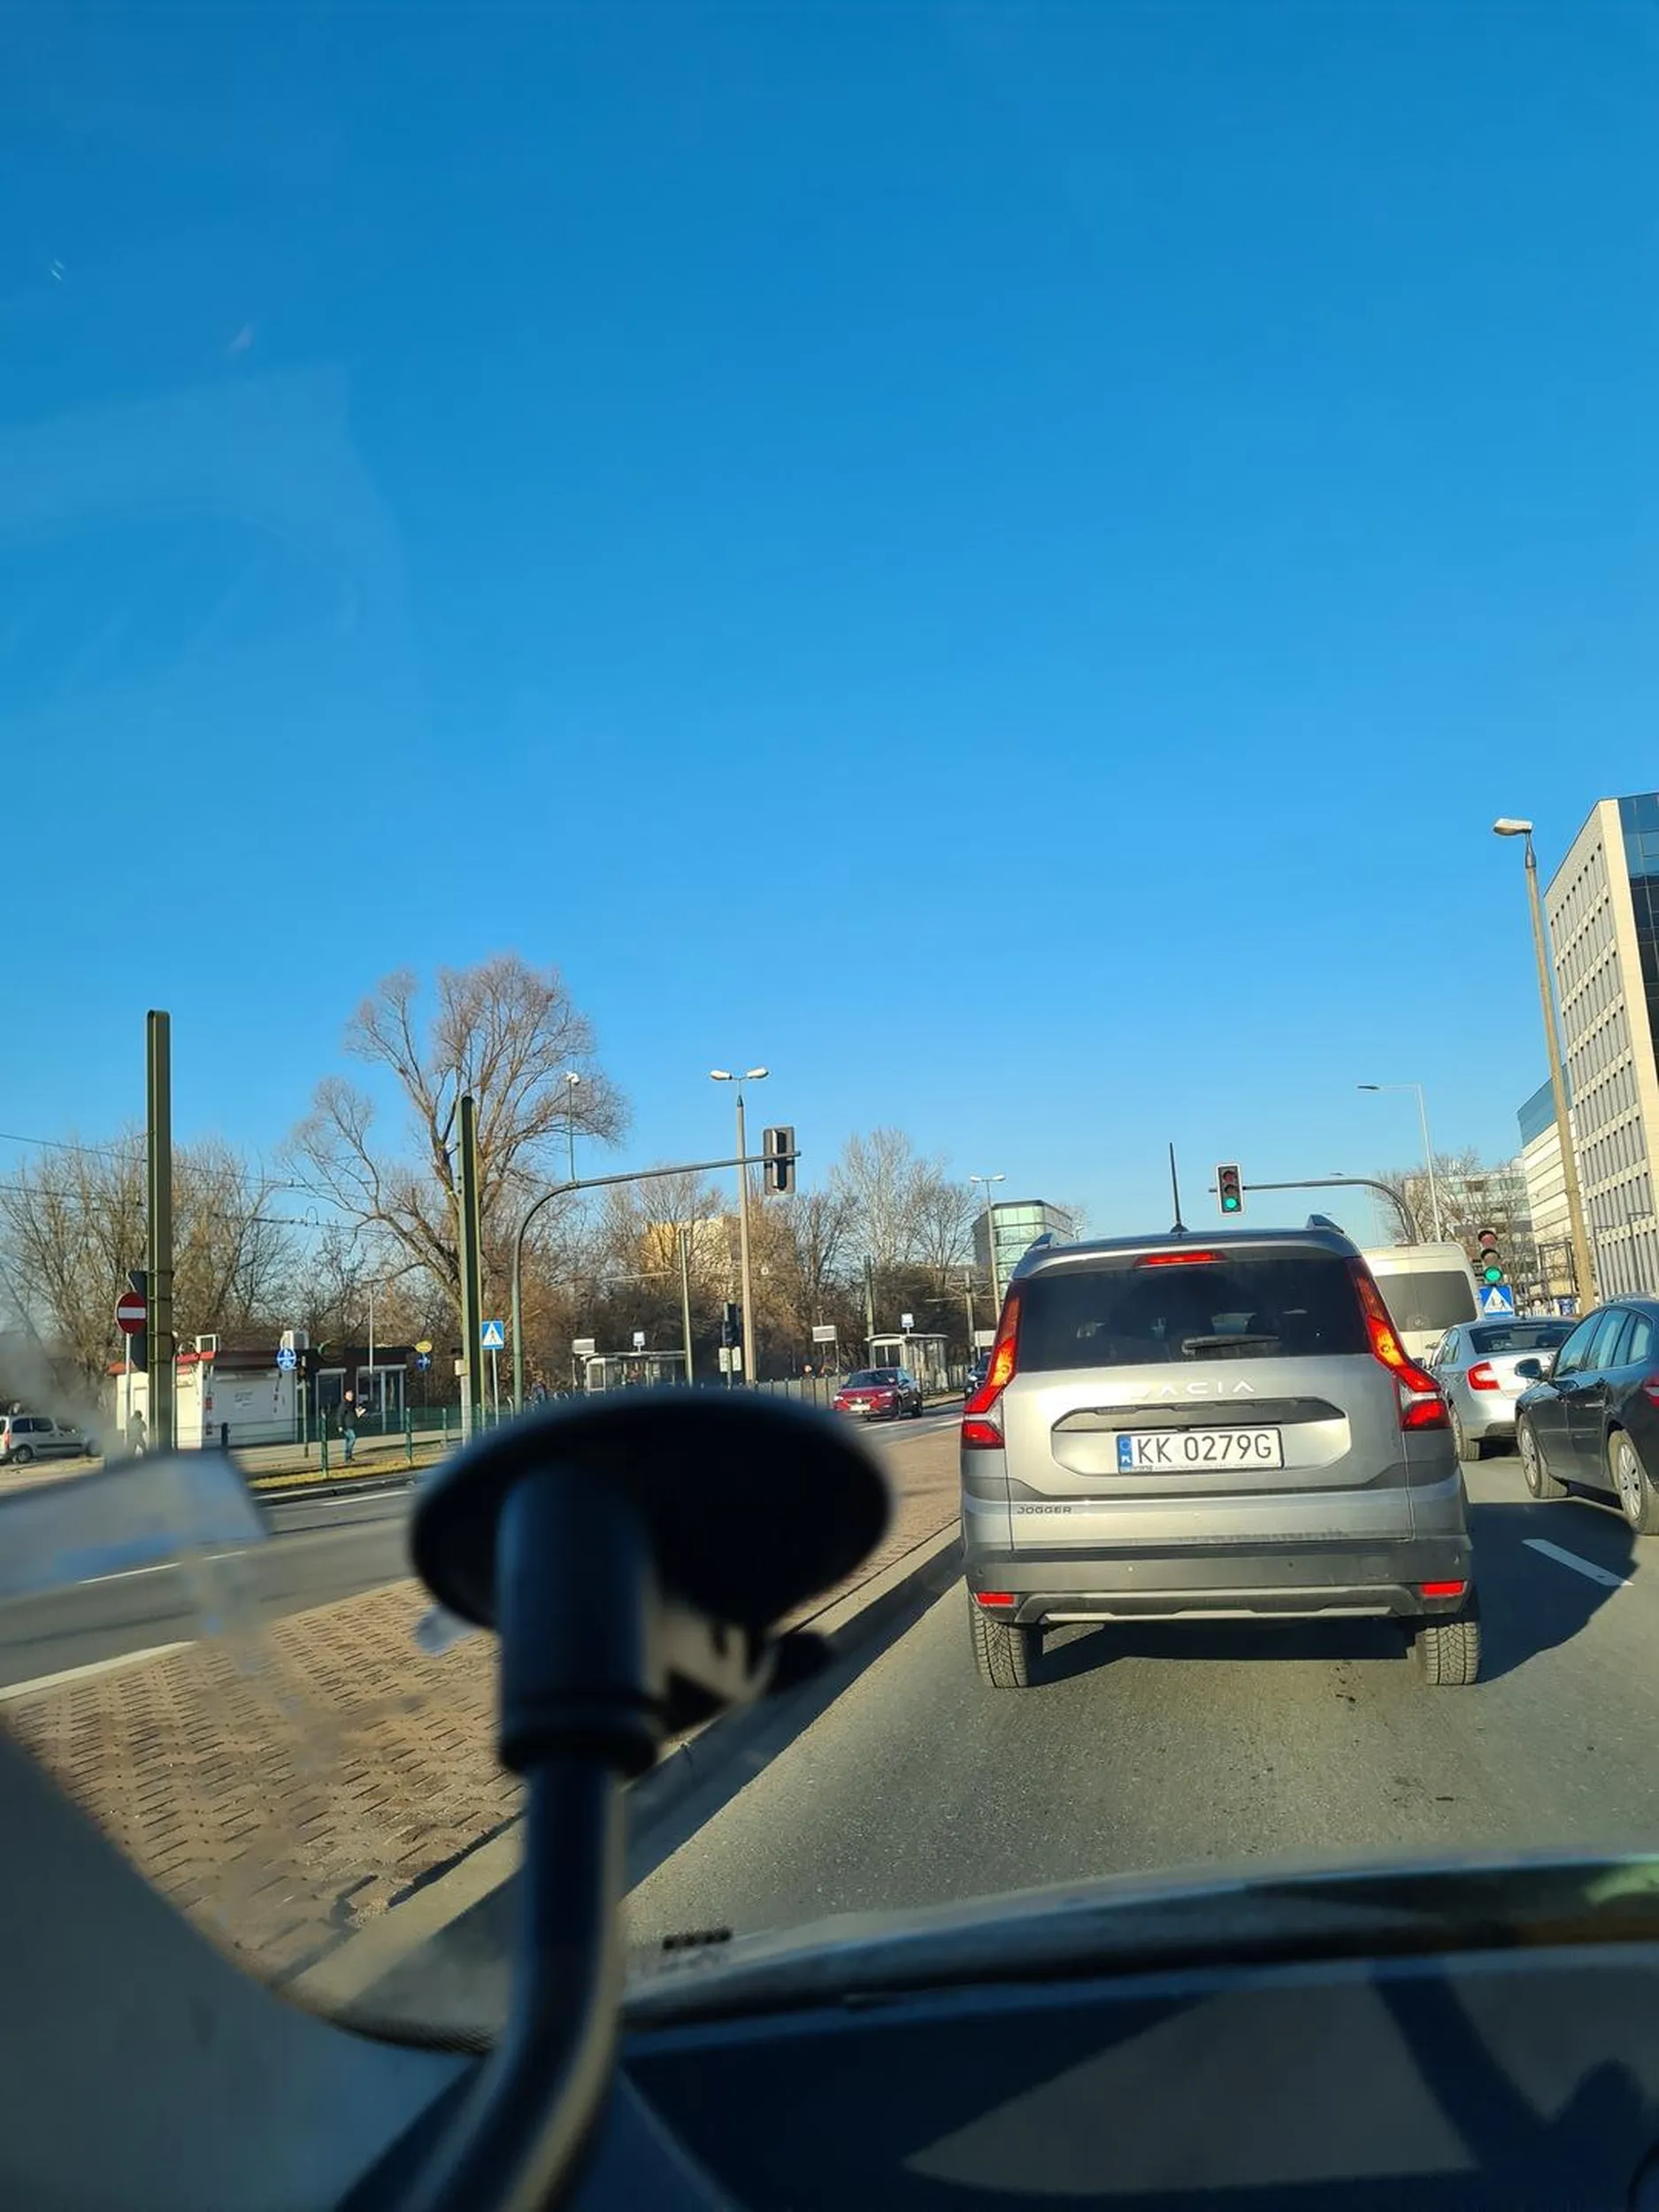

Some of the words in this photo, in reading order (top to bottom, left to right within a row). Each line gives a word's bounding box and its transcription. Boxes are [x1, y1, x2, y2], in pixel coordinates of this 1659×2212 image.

[1137, 1437, 1173, 1464] KK
[1184, 1433, 1272, 1462] 0279G
[1017, 1506, 1071, 1515] JOGGER
